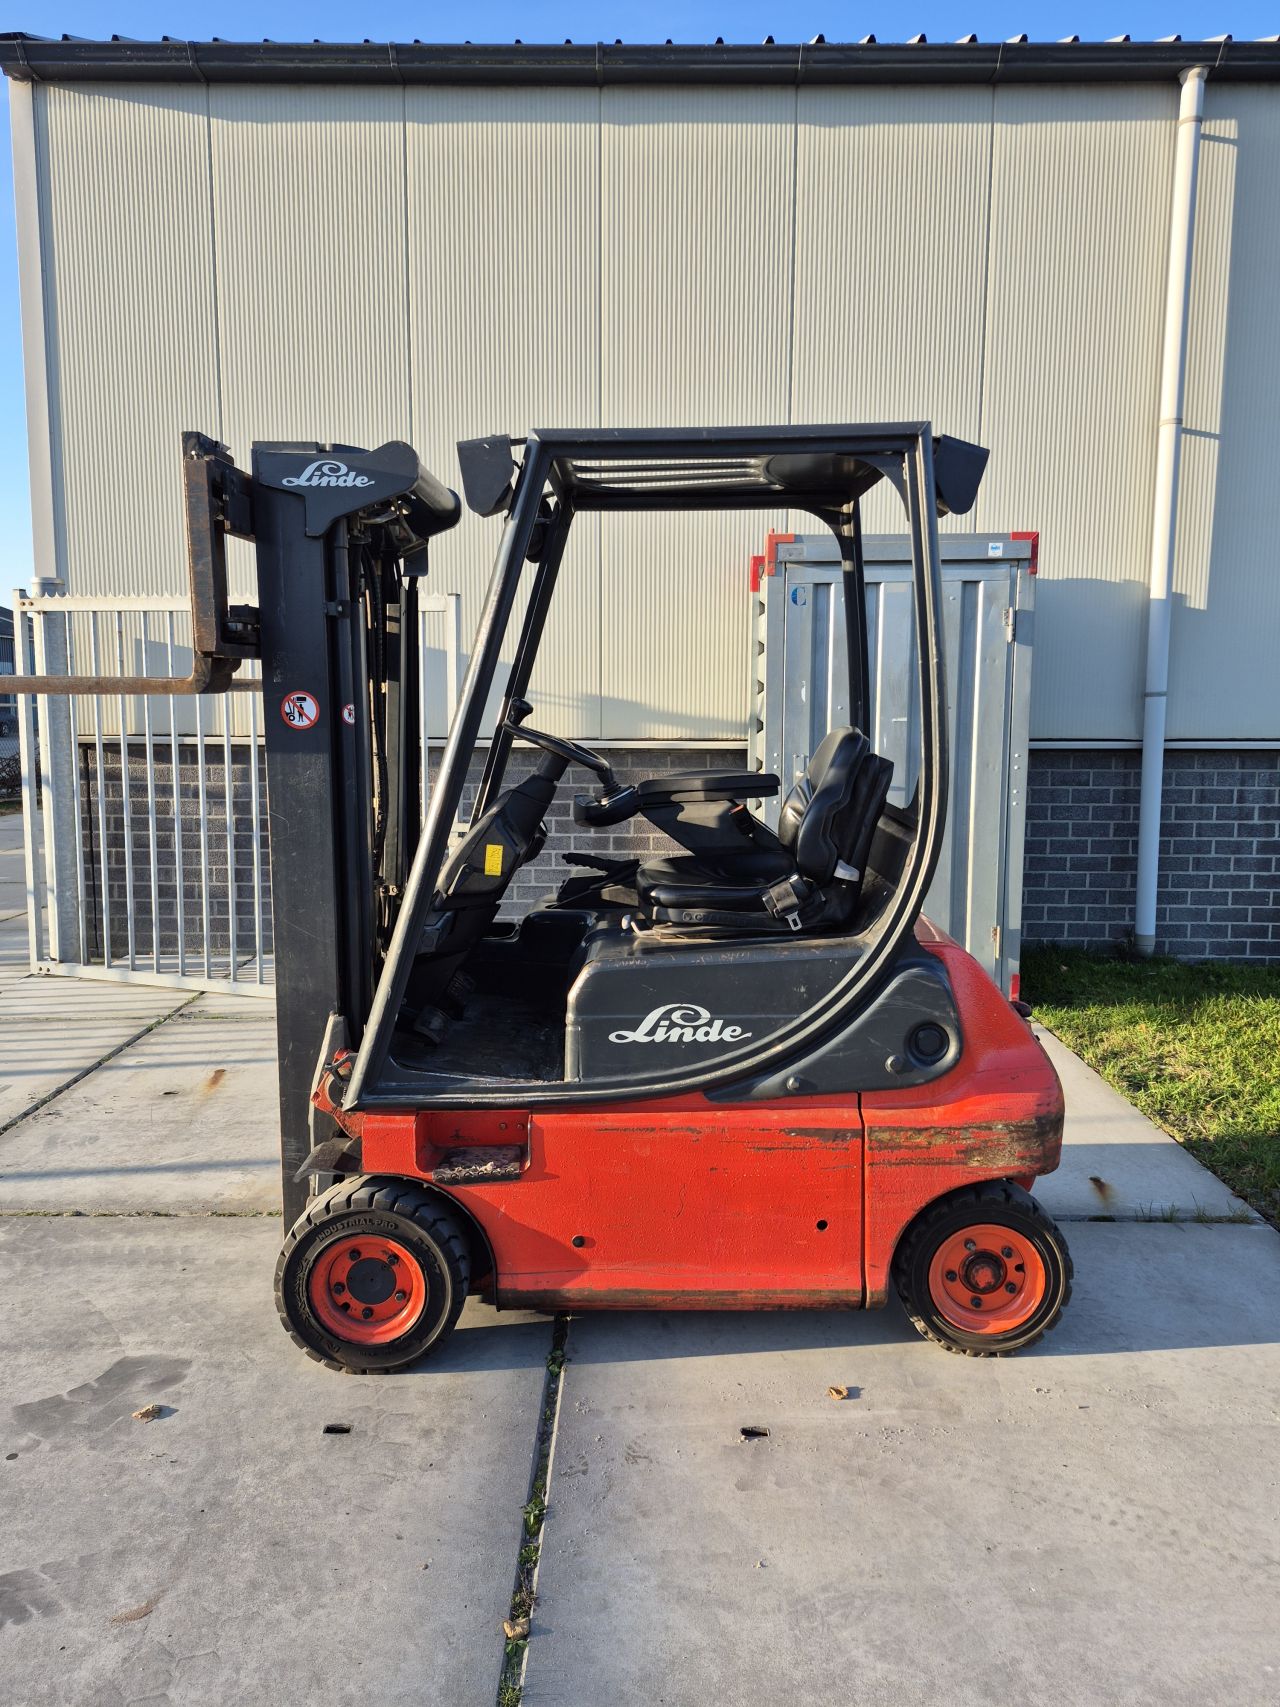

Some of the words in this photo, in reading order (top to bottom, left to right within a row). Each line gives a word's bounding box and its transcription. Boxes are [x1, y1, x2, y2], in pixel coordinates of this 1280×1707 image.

[281, 460, 375, 488] Linde
[608, 1003, 752, 1043] Linde
[316, 1218, 374, 1242] INDUSTRIAL
[374, 1219, 398, 1230] PRO
